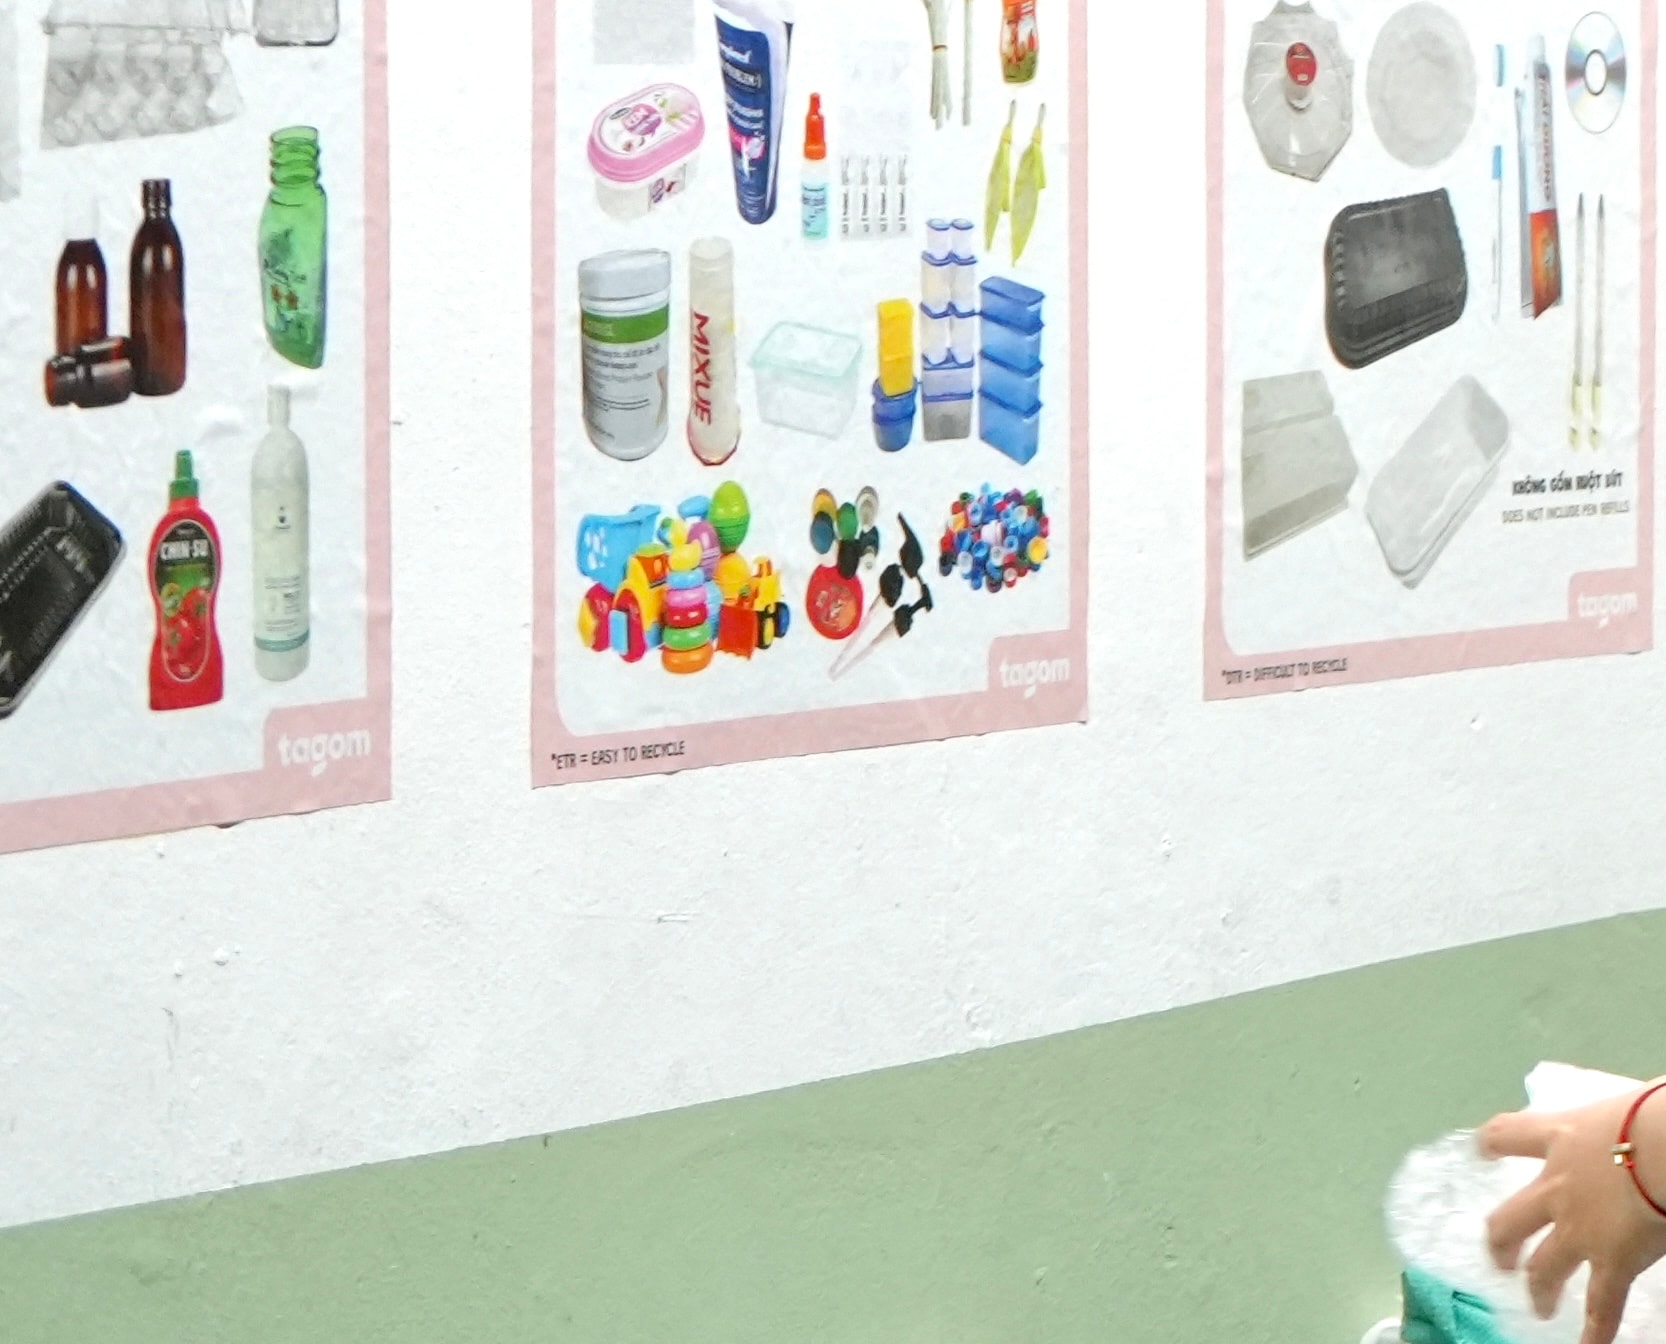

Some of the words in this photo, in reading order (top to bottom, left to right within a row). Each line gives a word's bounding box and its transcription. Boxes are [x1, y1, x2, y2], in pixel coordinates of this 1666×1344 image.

[694, 311, 712, 425] MIXUE
[999, 657, 1071, 698] tagom
[277, 726, 372, 777] tagom
